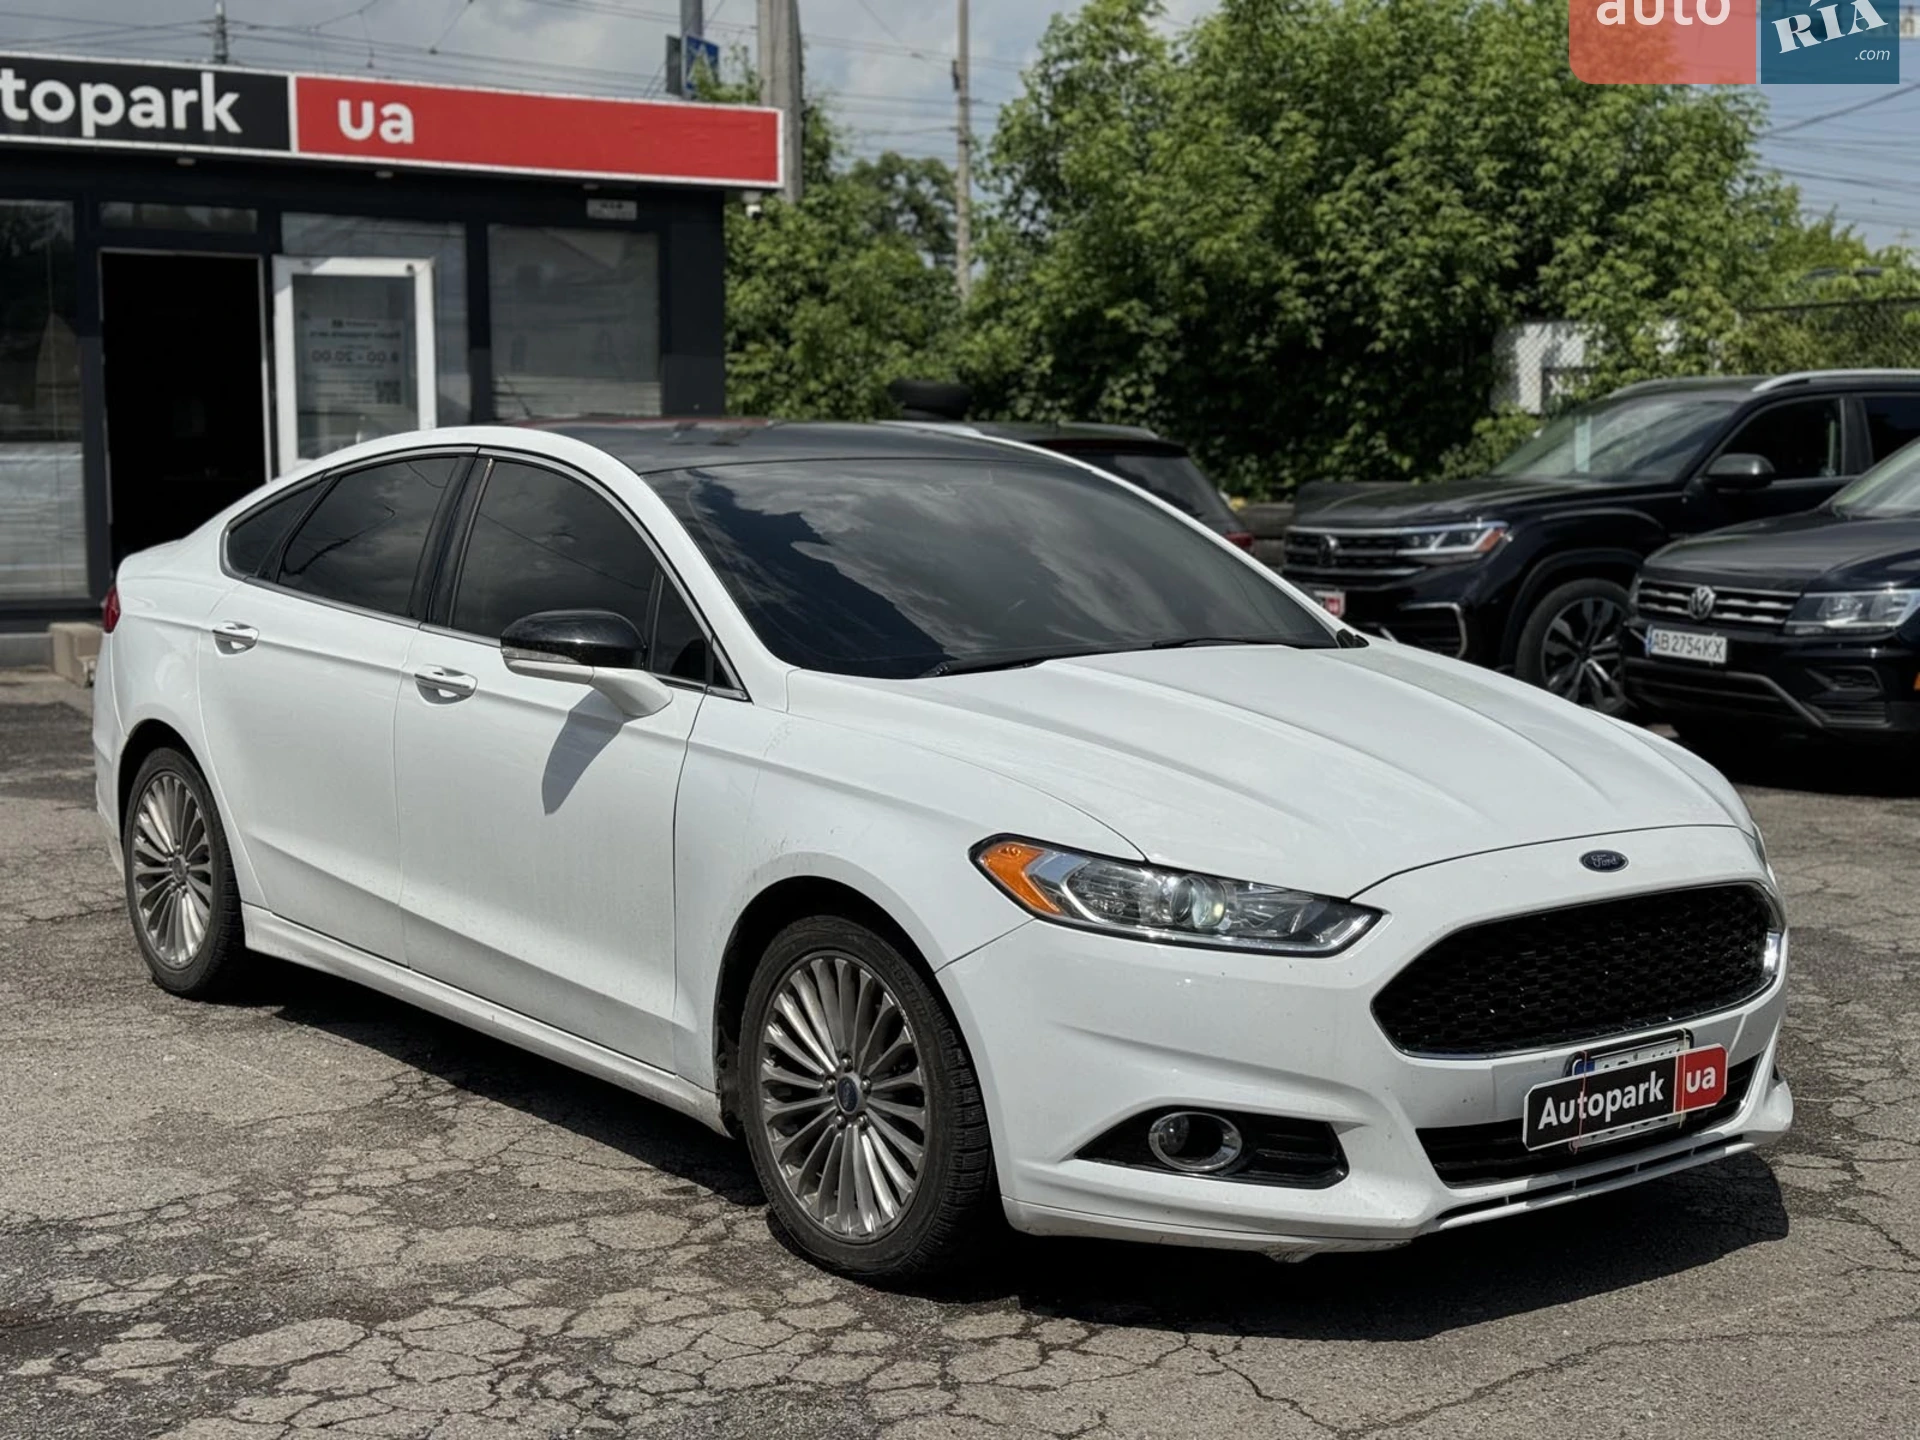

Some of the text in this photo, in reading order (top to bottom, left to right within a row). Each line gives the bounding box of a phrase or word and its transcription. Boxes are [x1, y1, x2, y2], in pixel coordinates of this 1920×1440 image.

[338, 99, 414, 144] ua
[1538, 1066, 1716, 1129] Autopark ua
